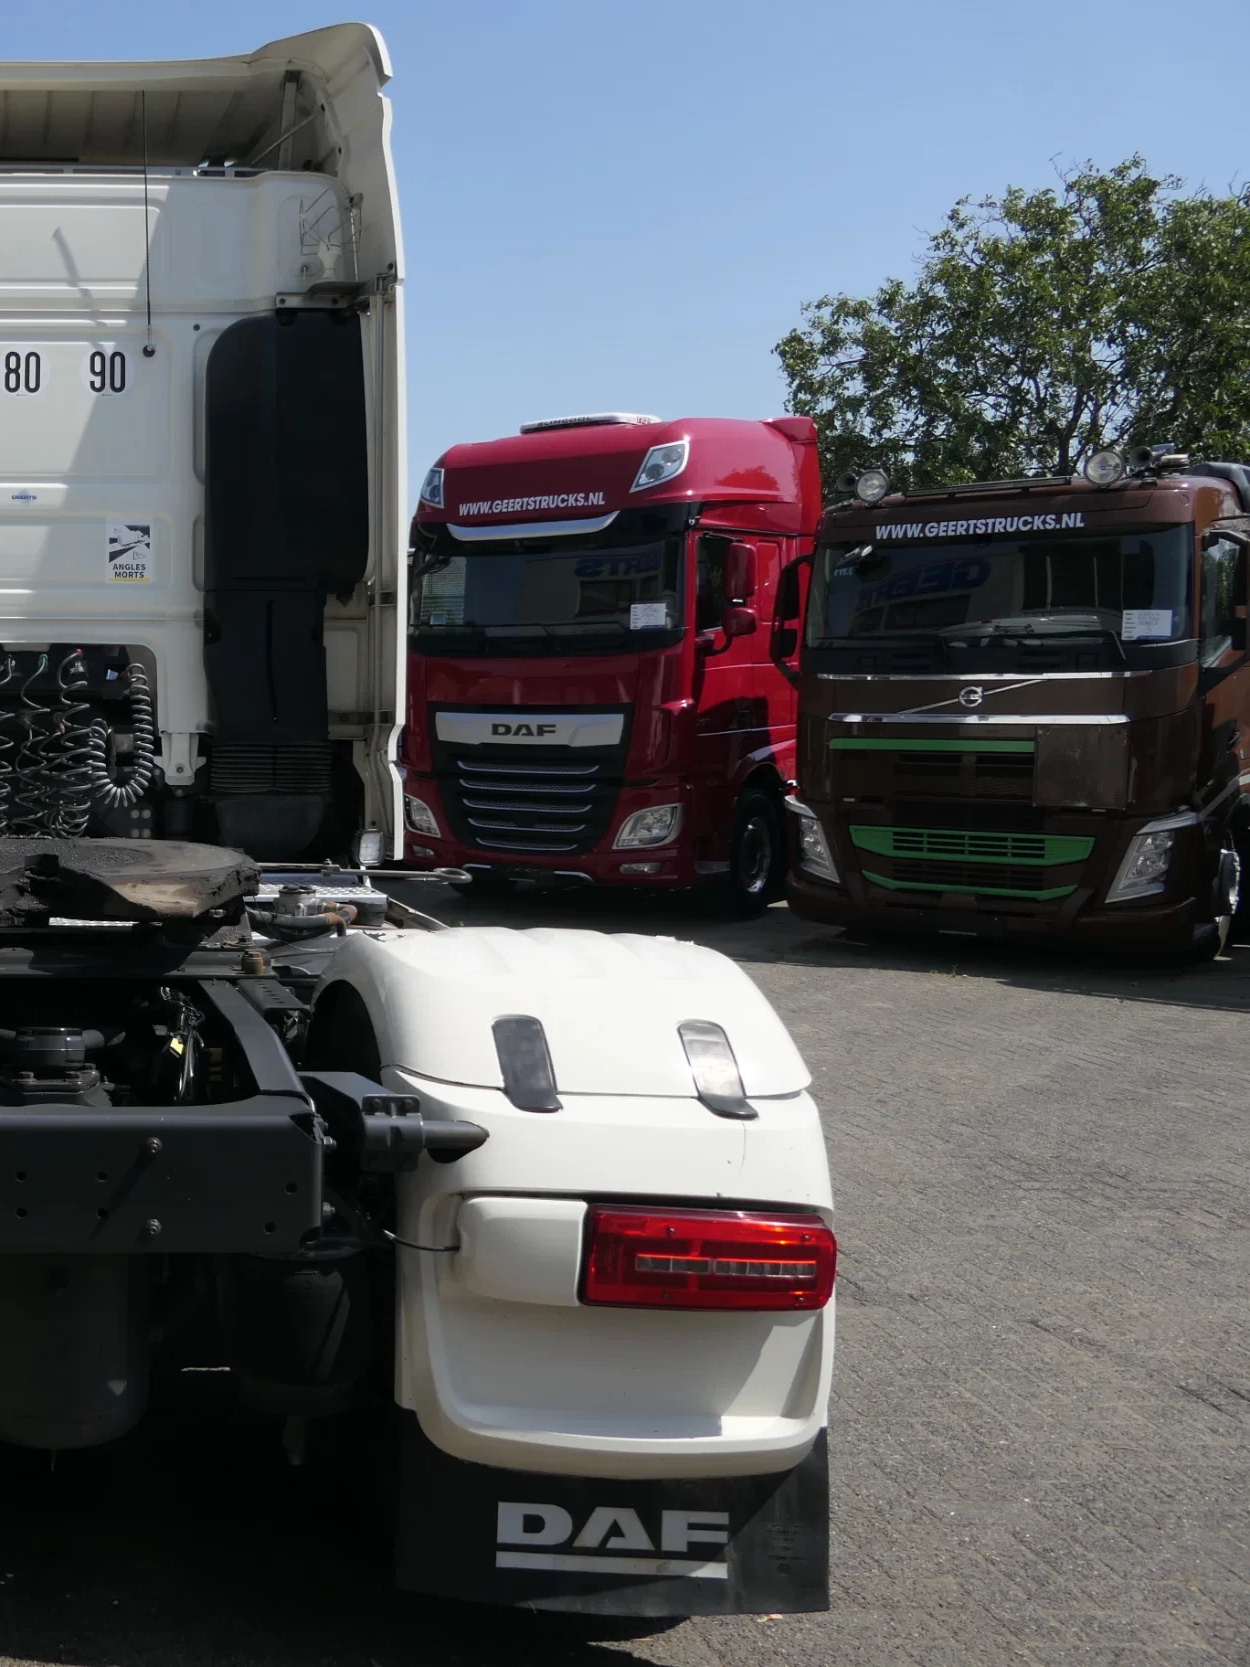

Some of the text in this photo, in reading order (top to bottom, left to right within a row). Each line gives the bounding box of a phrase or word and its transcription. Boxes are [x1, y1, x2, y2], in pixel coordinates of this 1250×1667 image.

[4, 351, 41, 393] 80
[89, 351, 126, 393] 90
[459, 492, 605, 516] WWW.GEERTSTRUCKS.NL
[875, 512, 1084, 539] WWW.GEERTSTRUCKS.NL
[112, 563, 146, 571] ANGLES
[114, 571, 145, 579] MORTS
[491, 723, 557, 737] DAF
[497, 1501, 730, 1552] DAF
